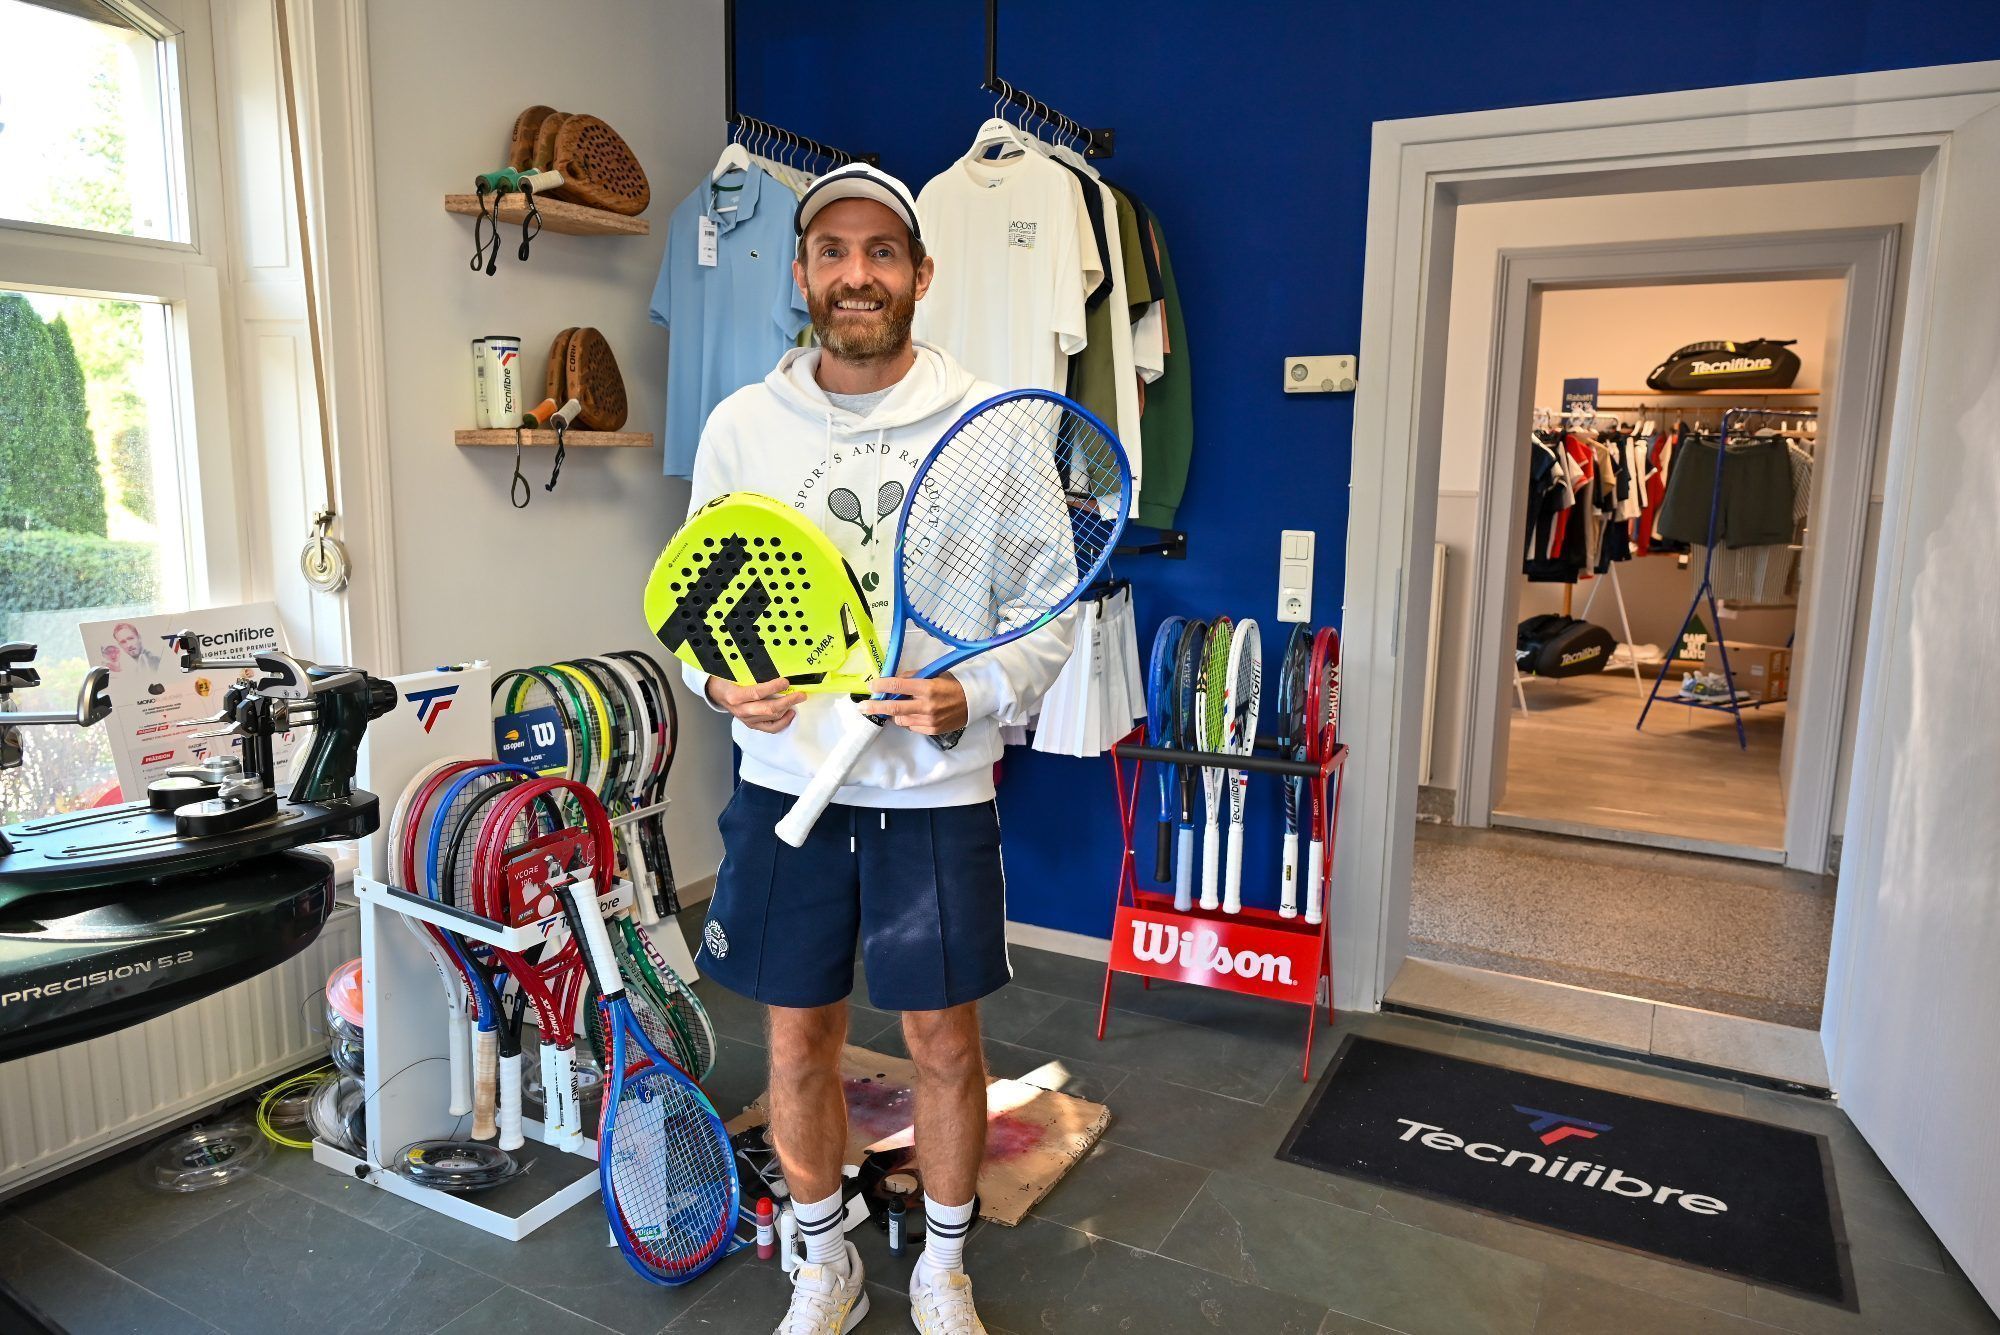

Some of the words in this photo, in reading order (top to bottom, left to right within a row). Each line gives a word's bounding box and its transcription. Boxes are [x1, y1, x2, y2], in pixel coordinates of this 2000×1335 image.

[569, 344, 577, 372] CORK
[1690, 357, 1772, 374] Tecnifibre
[503, 368, 513, 414] Tecnifibre
[852, 443, 891, 456] AND
[899, 450, 940, 527] RAQUET
[246, 642, 277, 651] PREMIUM
[806, 634, 835, 666] BOMBA
[1231, 777, 1241, 824] Tecnifibre
[514, 865, 539, 880] VCORE
[1131, 919, 1293, 985] Wilson
[1, 960, 153, 1007] PRECISION
[158, 950, 194, 969] 5.2
[532, 1005, 545, 1031] YONEX
[548, 1010, 560, 1036] YONEX
[570, 1074, 580, 1104] YONEX
[1396, 1117, 1729, 1215] Tecnifibre
